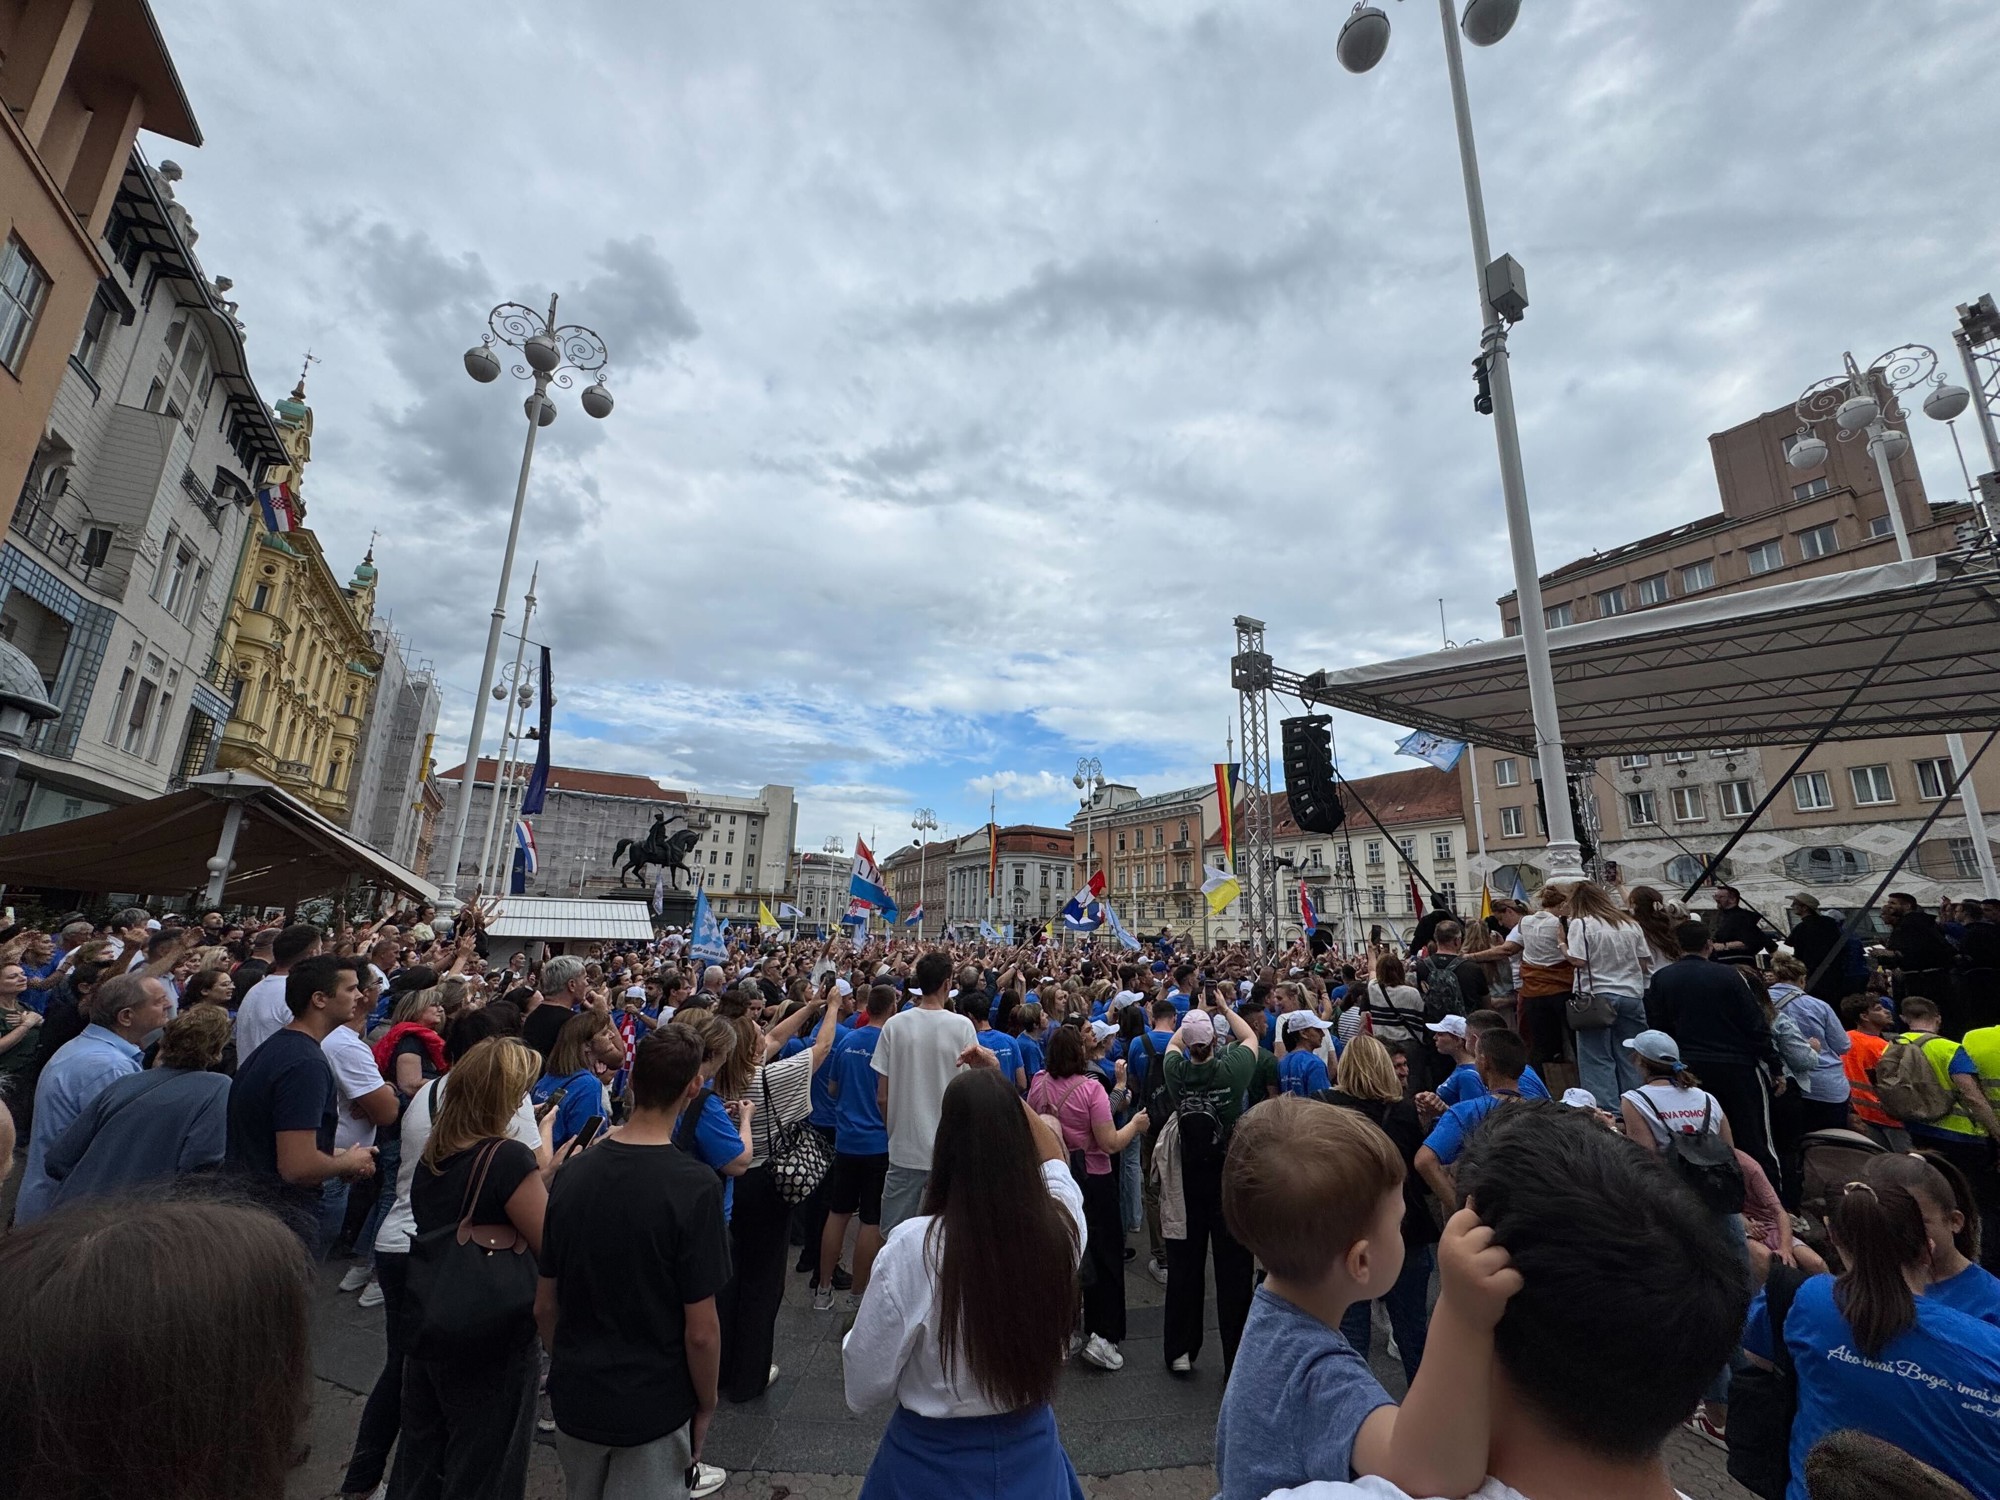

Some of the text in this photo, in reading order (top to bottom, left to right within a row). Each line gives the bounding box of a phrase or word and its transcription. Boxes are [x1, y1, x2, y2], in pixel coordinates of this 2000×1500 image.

[1827, 1344, 1861, 1364] Ako
[1896, 1359, 1954, 1391] Boga,
[1957, 1381, 1991, 1401] imaš
